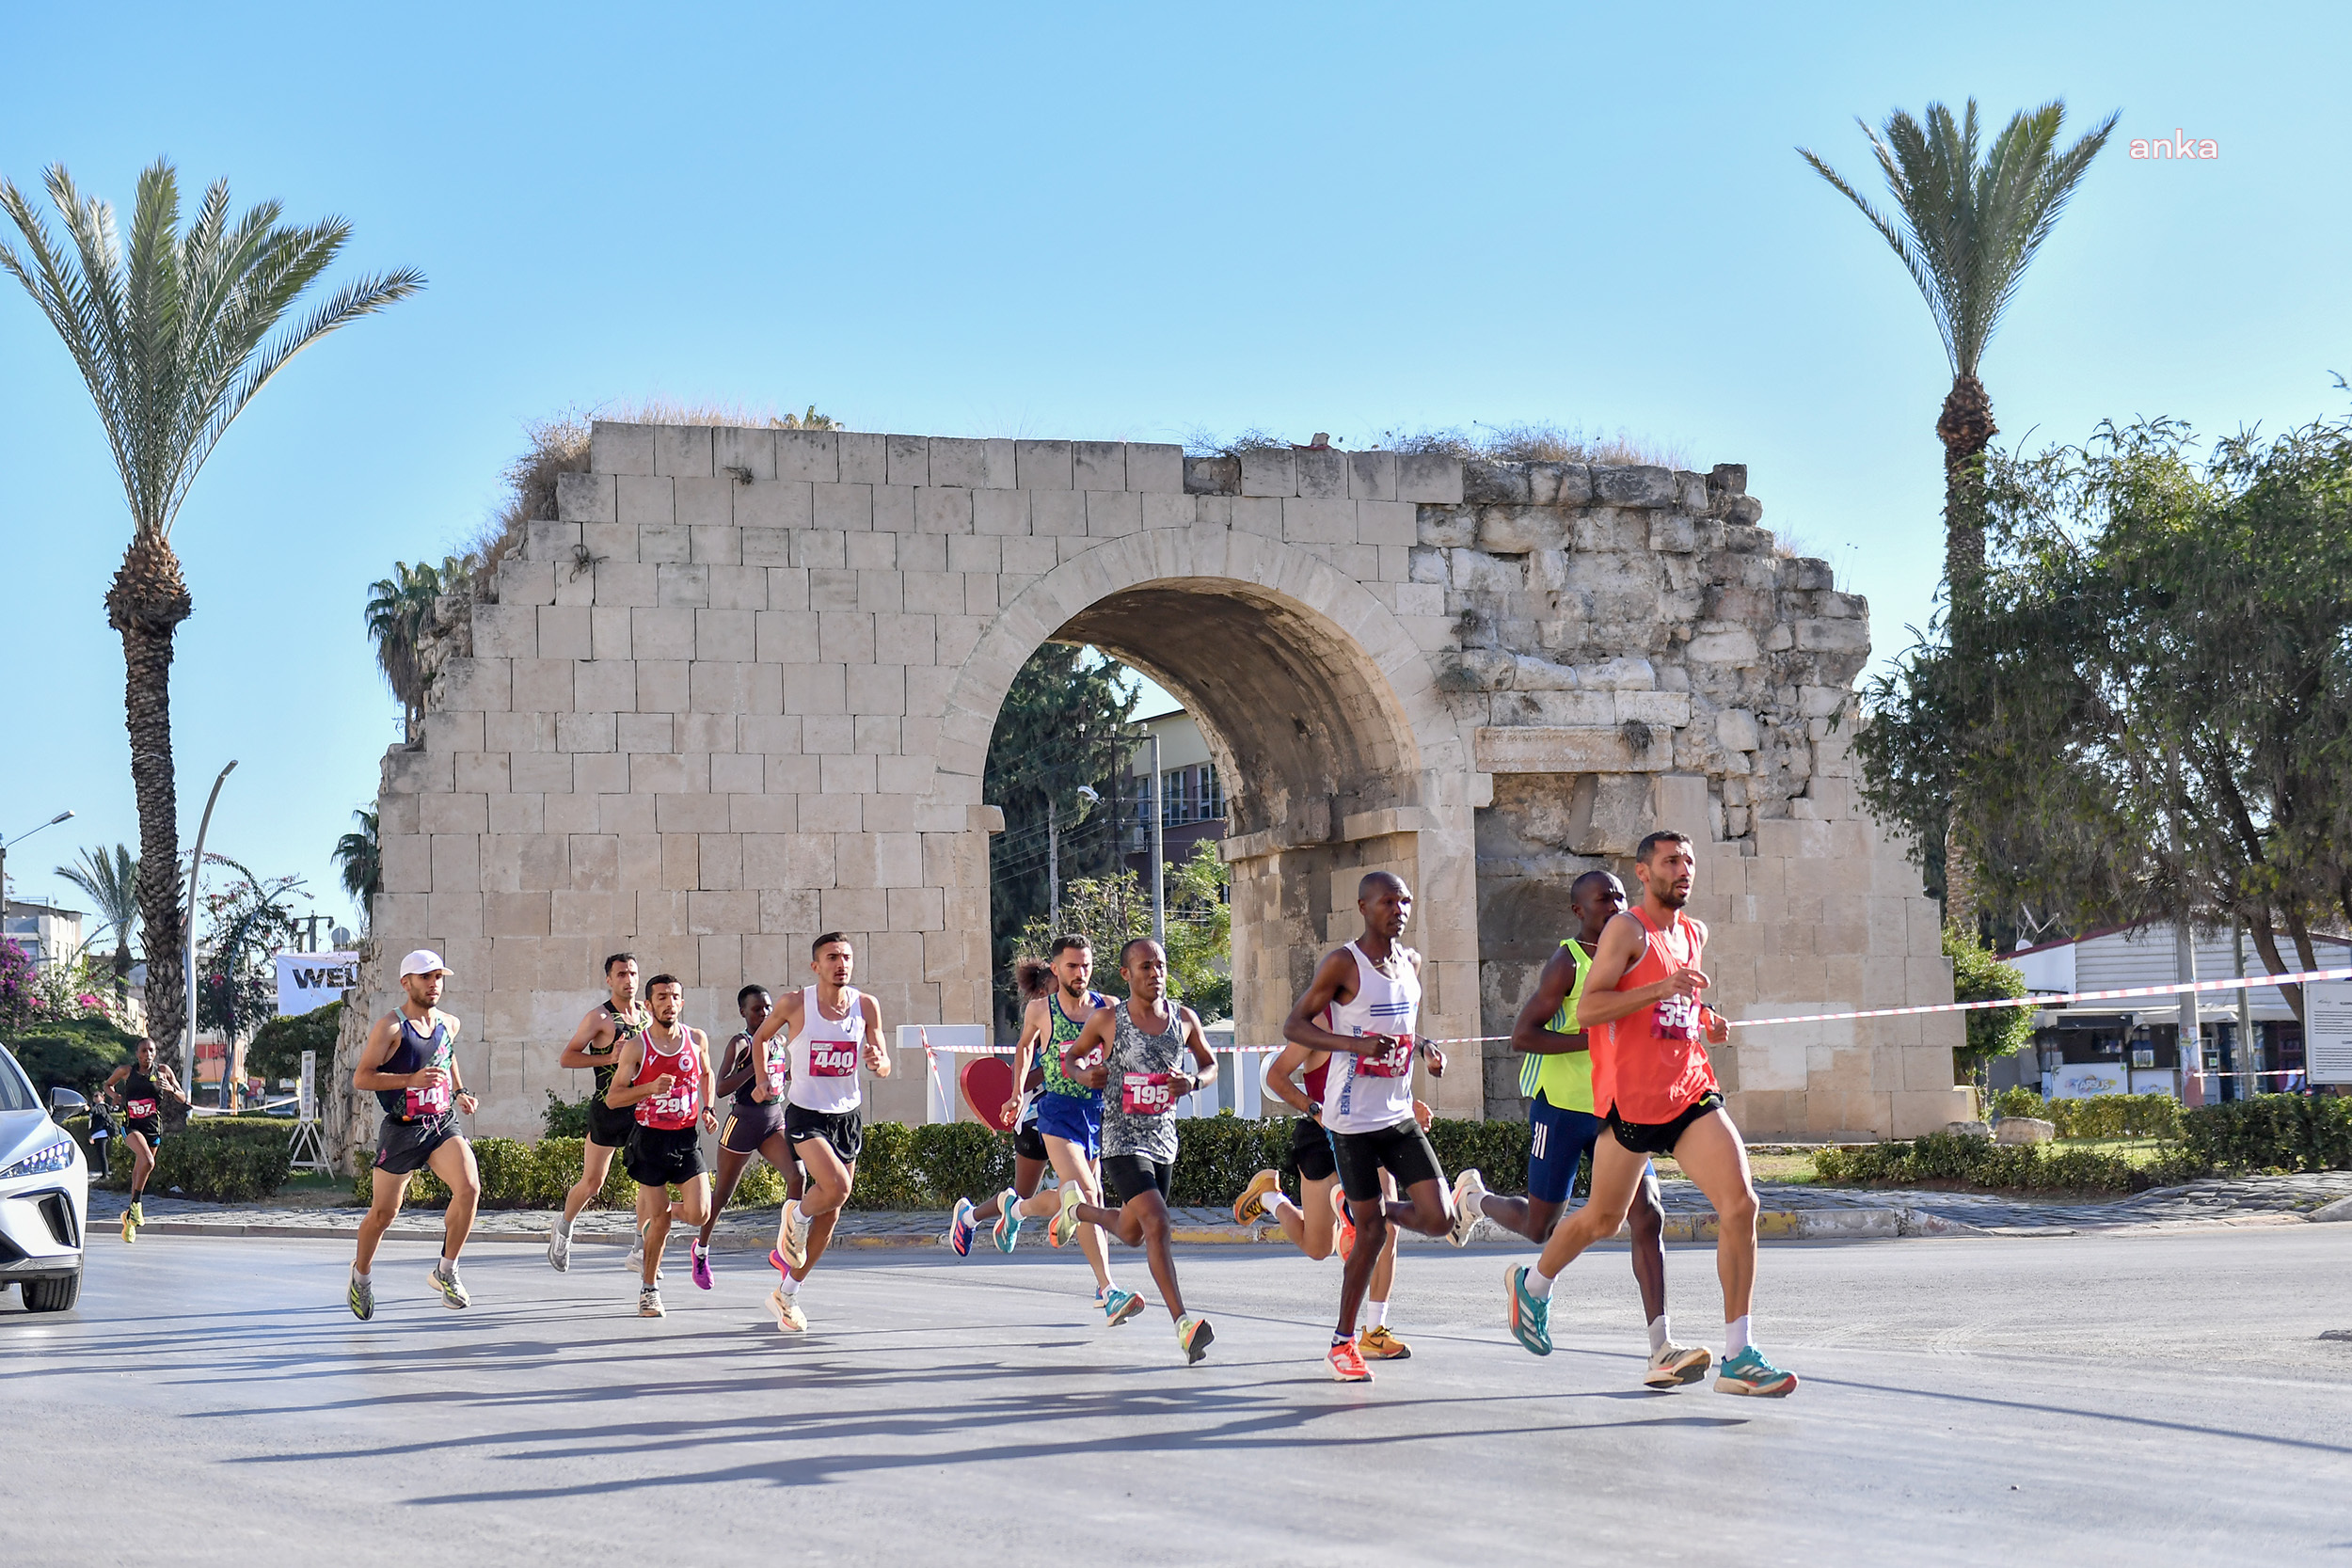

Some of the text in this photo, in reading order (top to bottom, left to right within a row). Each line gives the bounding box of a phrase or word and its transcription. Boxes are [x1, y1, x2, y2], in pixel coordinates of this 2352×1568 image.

[815, 1051, 853, 1068] 440
[416, 1085, 444, 1106] 141
[1131, 1085, 1169, 1104] 195
[132, 1103, 152, 1115] 197
